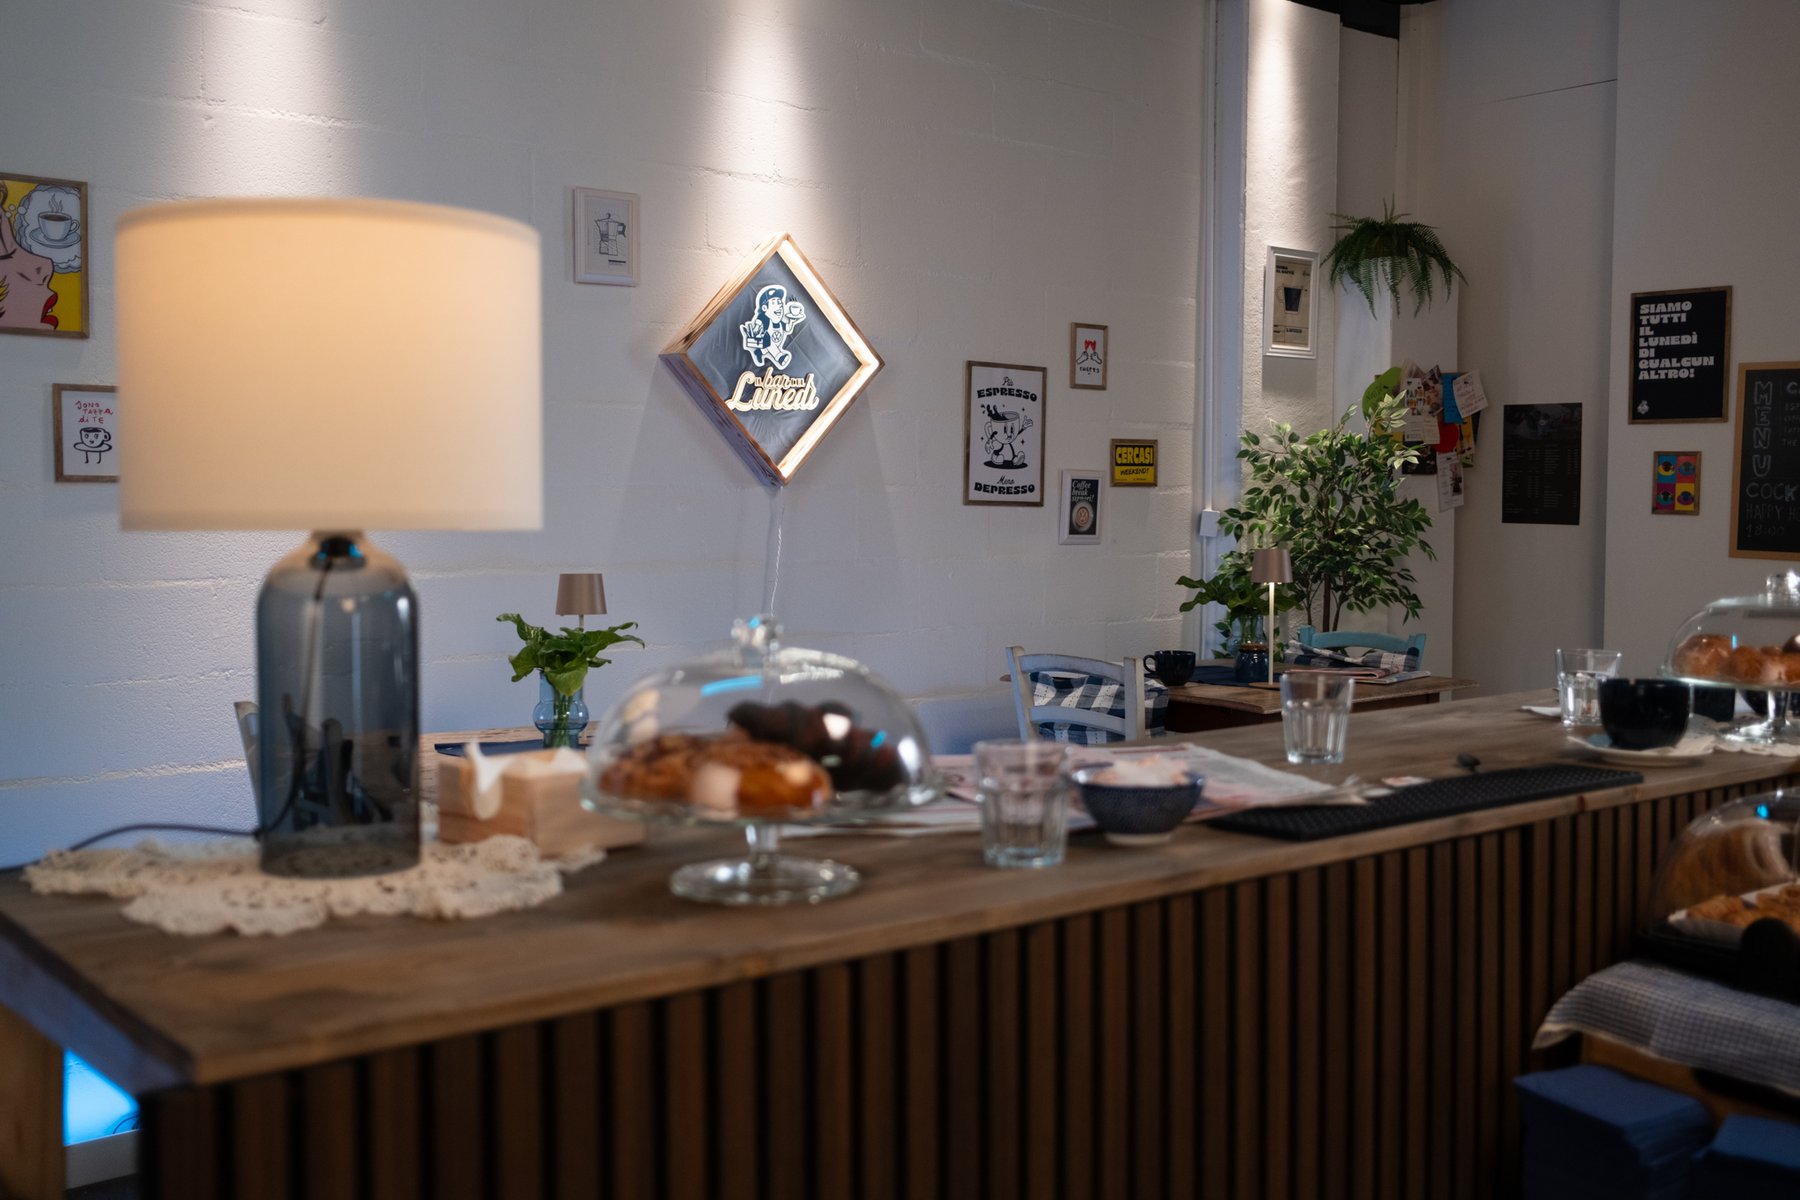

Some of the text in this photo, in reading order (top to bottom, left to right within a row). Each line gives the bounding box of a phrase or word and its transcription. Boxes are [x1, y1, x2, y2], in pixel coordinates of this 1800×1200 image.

[1640, 301, 1692, 314] SIAMO
[1640, 313, 1687, 325] TUTTI
[1639, 326, 1654, 336] IL
[1639, 332, 1698, 347] LUNEDÌ
[1639, 348, 1655, 358] DI
[762, 366, 790, 389] bar
[1638, 368, 1695, 380] ALTRO!
[977, 387, 1037, 402] ESPRESSO
[1116, 447, 1153, 464] CERCASI
[974, 482, 1035, 495] DEPRESSO
